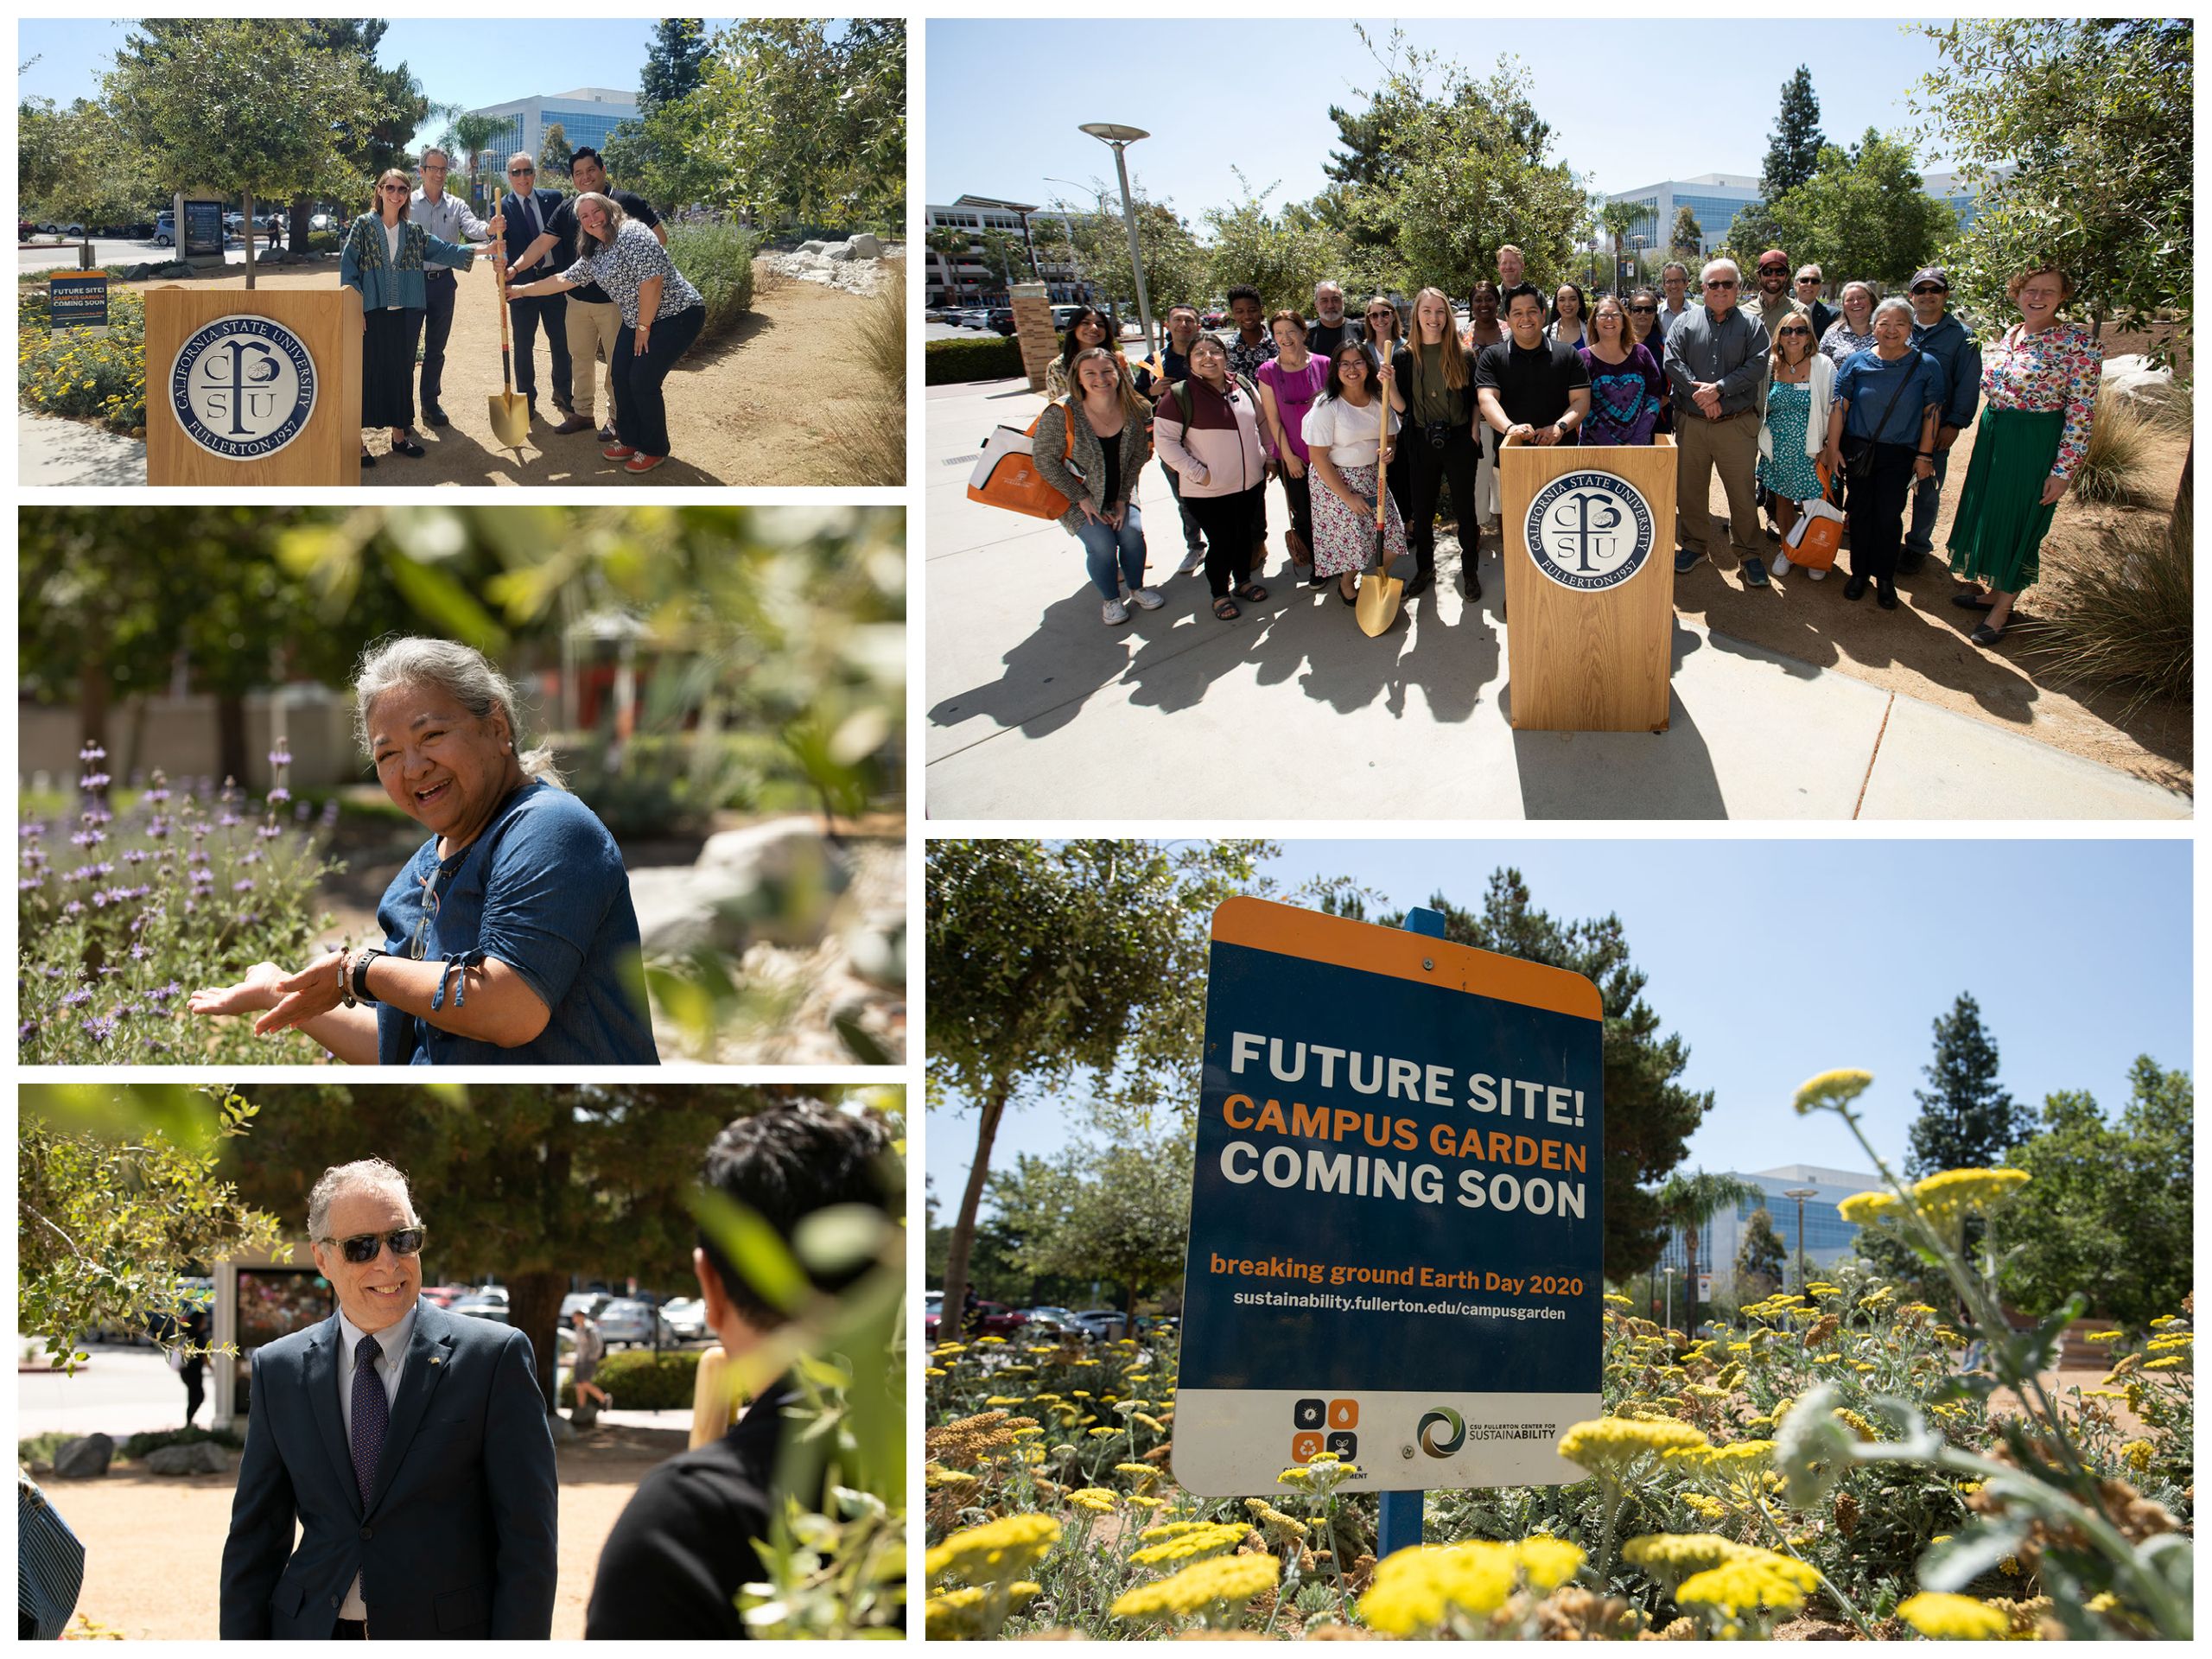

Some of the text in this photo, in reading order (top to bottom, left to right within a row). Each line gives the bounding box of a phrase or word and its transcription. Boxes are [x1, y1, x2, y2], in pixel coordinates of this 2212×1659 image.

[175, 321, 312, 410] CALIFORNIA STATE UNIVERSITY
[1528, 476, 1649, 551] CALIFORNIA STATE UNIVERSITY
[1230, 1031, 1586, 1128] FUTURE SITE!
[1223, 1093, 1586, 1173] CAMPUS GARDEN
[1219, 1141, 1586, 1219] COMING SOON
[1210, 1253, 1584, 1296] breaking ground Earth Day 2020
[1233, 1291, 1566, 1321] sustainability.fullerton.edu/campusgarden
[1470, 1429, 1556, 1440] SUSTAINABILITY
